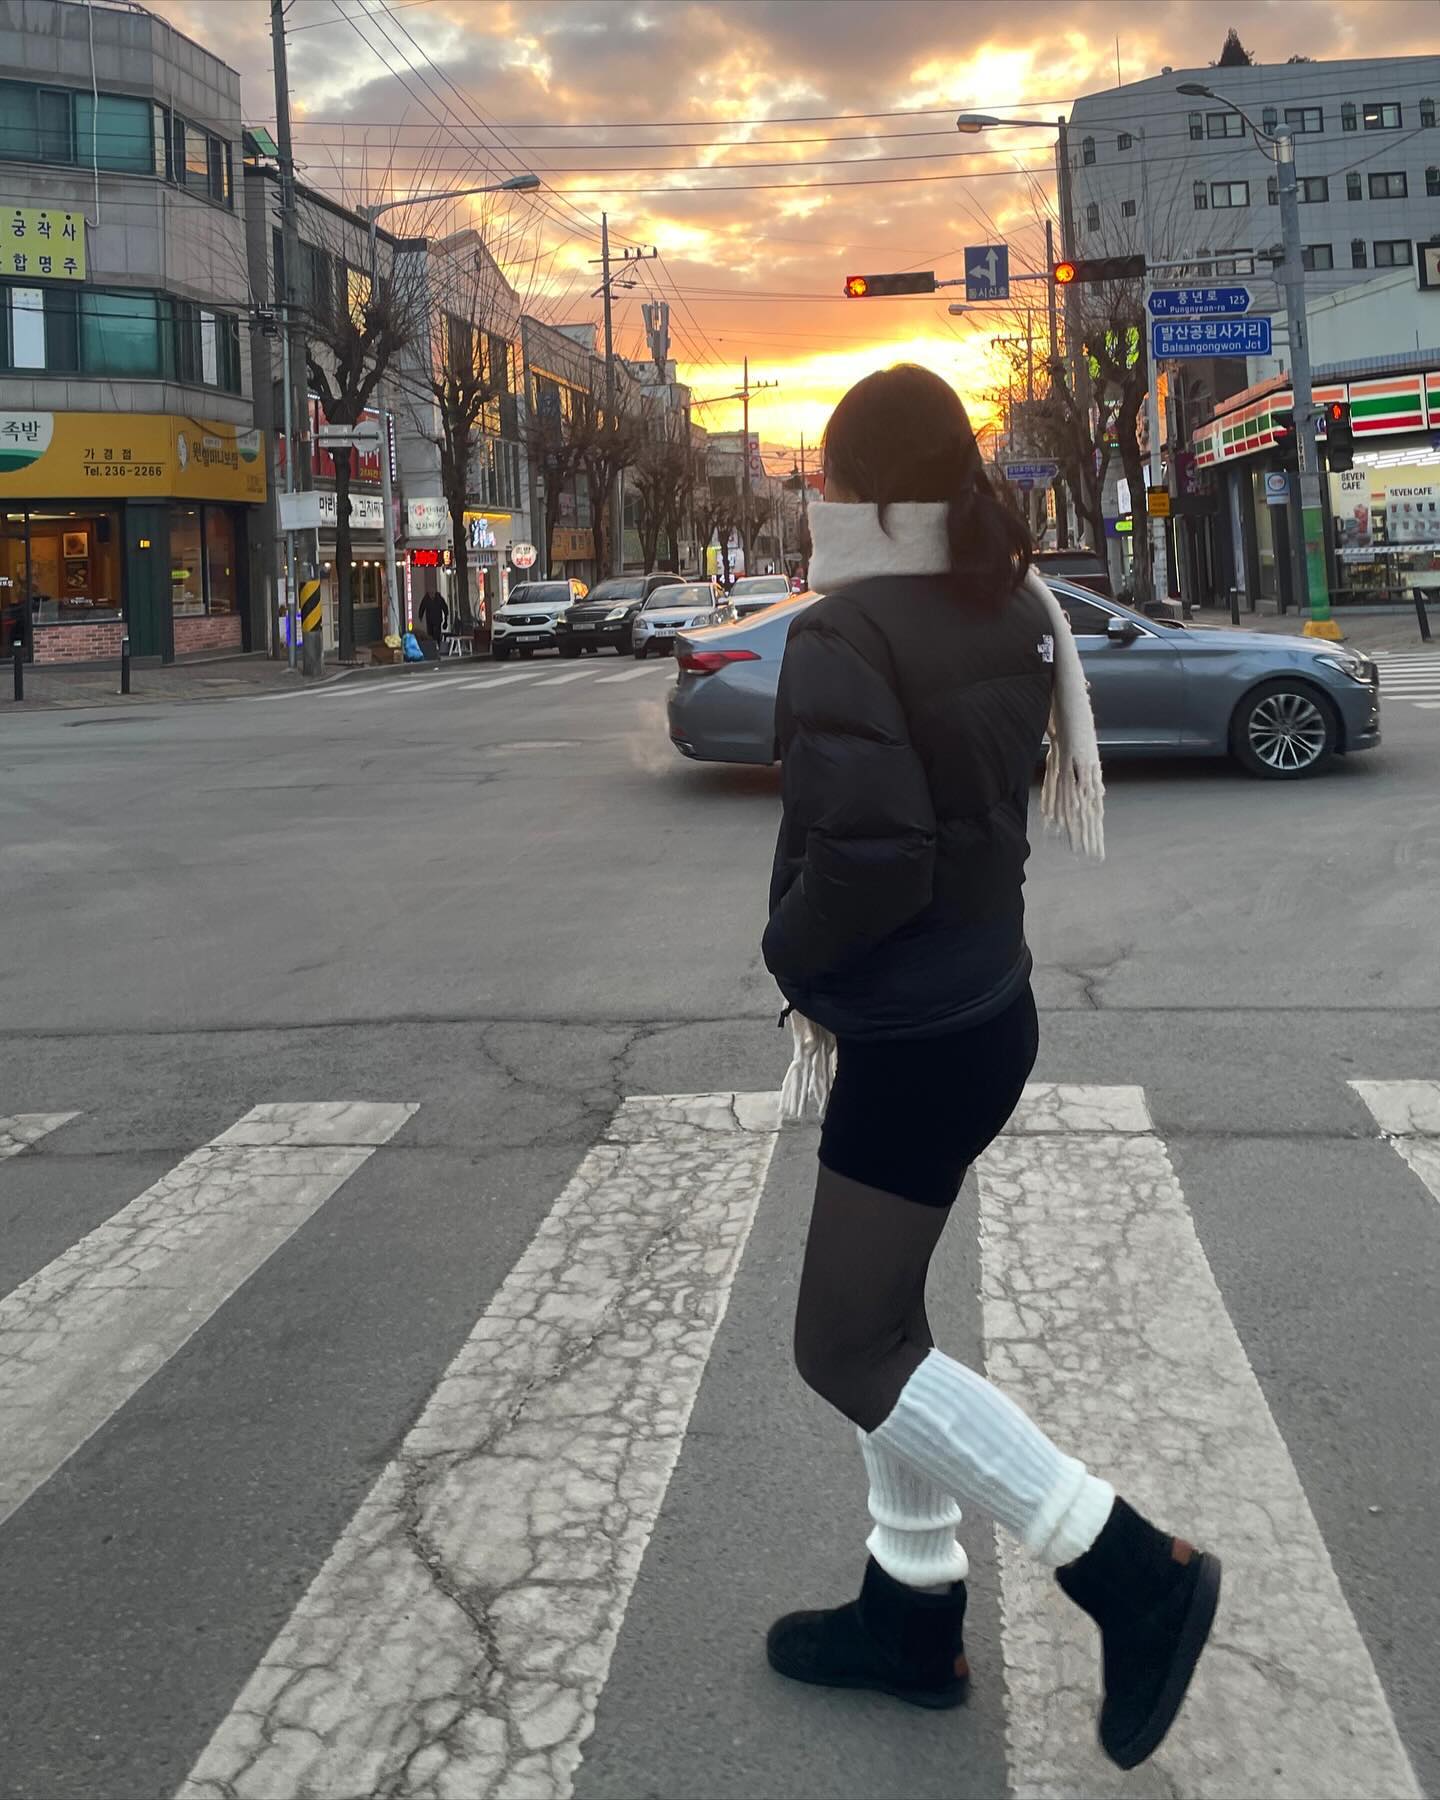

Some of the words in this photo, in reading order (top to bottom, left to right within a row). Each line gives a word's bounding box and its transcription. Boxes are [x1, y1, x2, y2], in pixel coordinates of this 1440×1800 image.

[1178, 290, 1218, 305] 풍년로
[1229, 295, 1246, 305] 125
[1152, 299, 1167, 309] 121
[1161, 322, 1262, 341] 발산공원사거리
[1162, 341, 1241, 354] Balsangongwon
[1245, 339, 1261, 350] Jct
[1, 420, 41, 442] 족발
[1341, 472, 1366, 481] SEVEN
[1341, 481, 1361, 491] CAFE
[1390, 488, 1414, 497] SEVEN
[1413, 486, 1433, 496] CAFE
